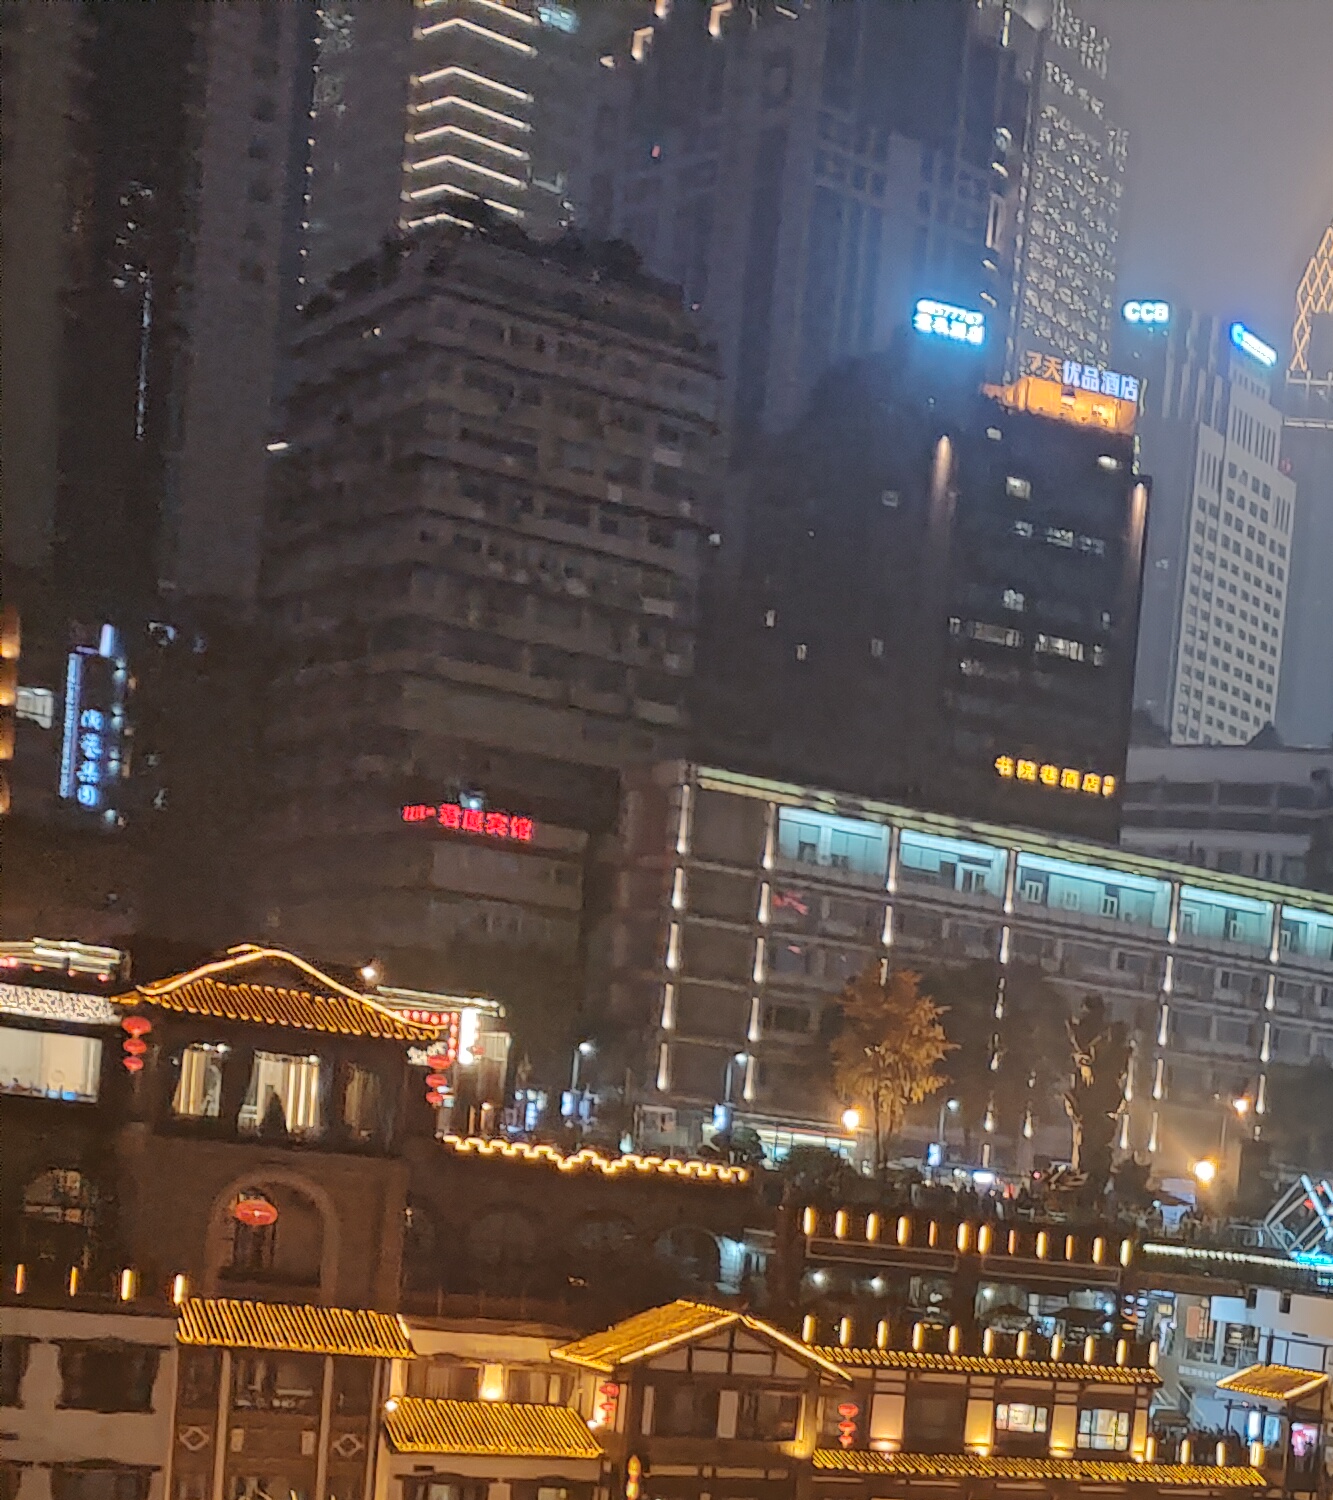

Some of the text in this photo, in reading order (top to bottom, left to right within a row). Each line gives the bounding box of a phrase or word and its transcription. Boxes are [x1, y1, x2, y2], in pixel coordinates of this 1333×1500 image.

[1123, 301, 1169, 322] CCB
[1025, 351, 1139, 402] 7天优品酒店
